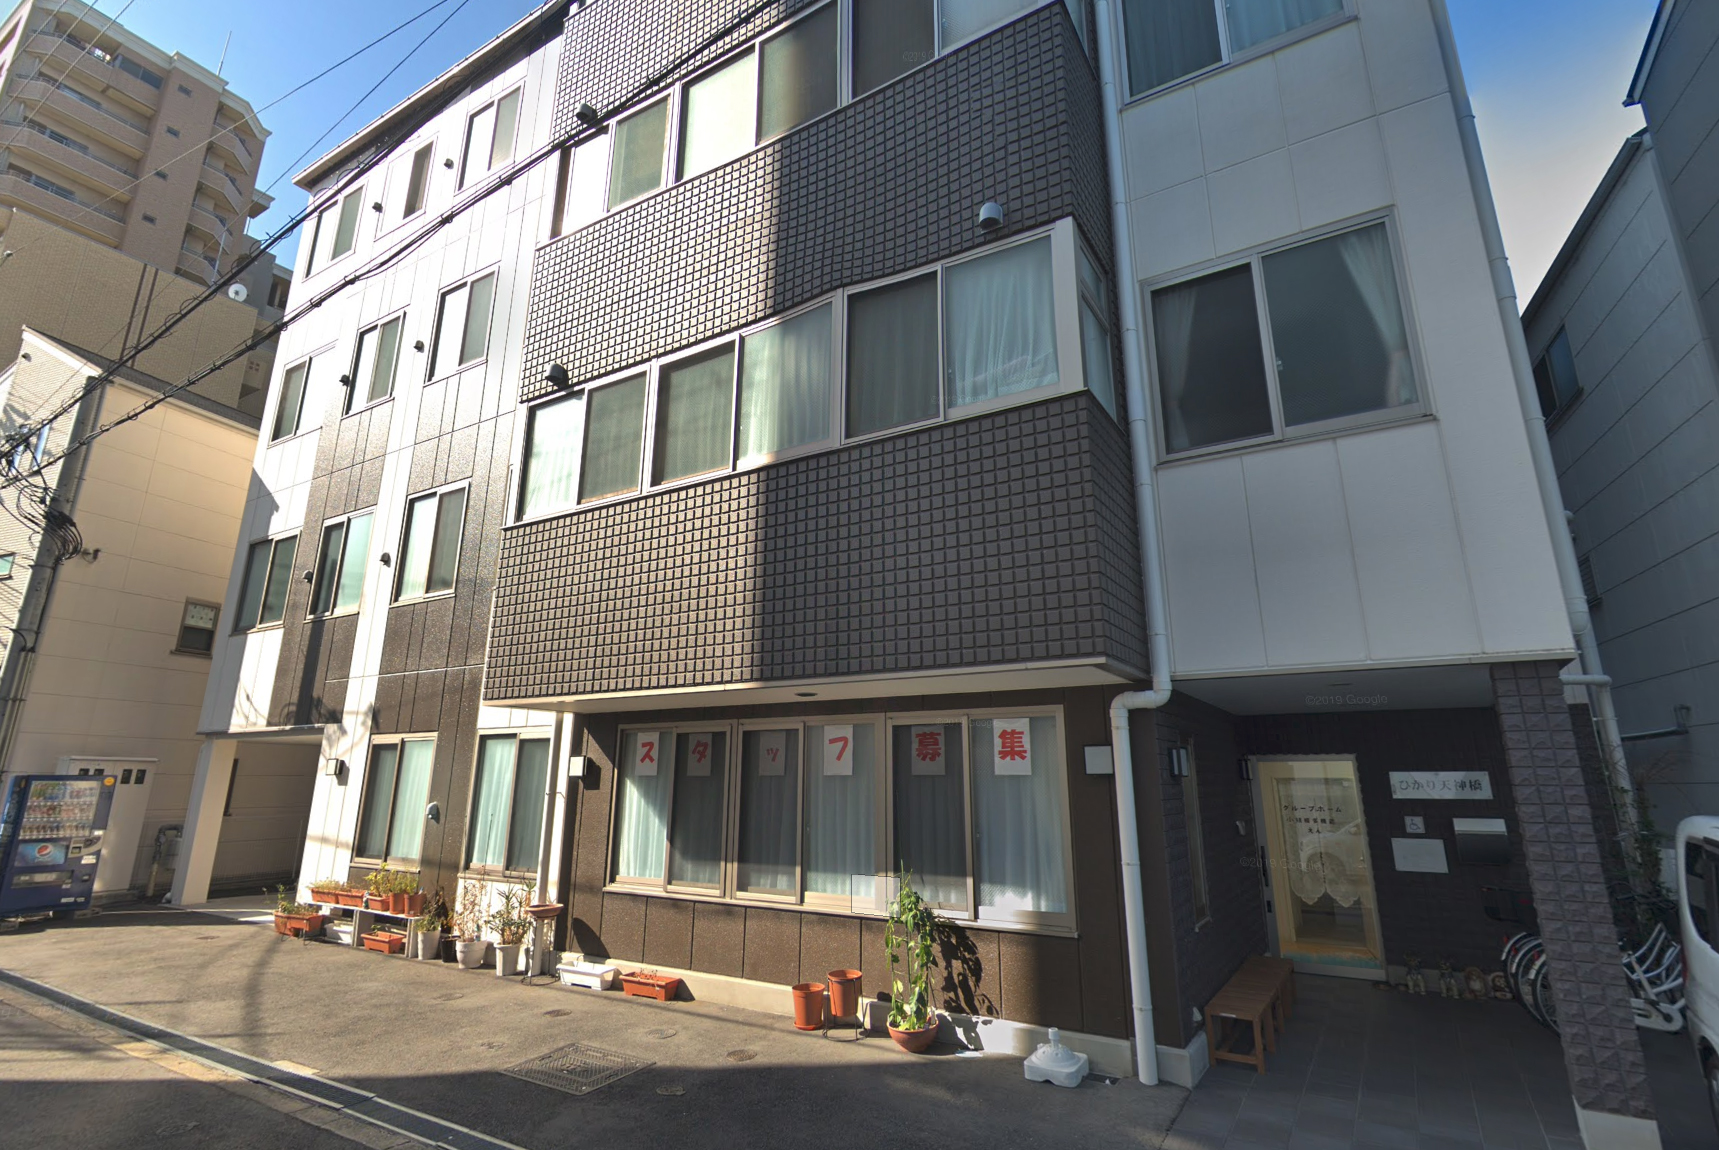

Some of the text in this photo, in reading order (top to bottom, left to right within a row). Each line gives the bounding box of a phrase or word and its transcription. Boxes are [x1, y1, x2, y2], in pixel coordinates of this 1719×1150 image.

[1398, 779, 1482, 791] ひかり天神橋
[1283, 804, 1342, 812] グループホーム
